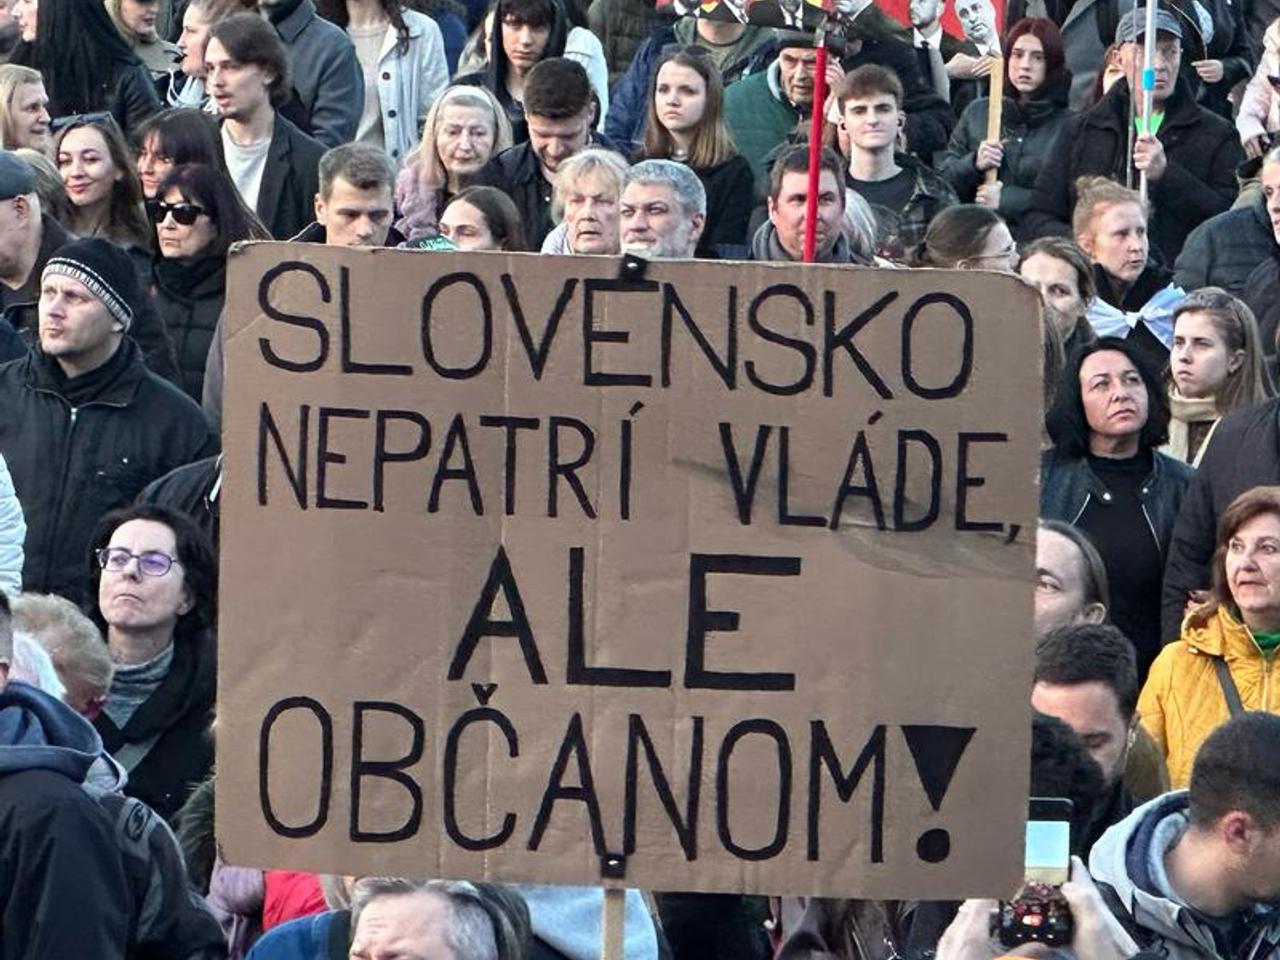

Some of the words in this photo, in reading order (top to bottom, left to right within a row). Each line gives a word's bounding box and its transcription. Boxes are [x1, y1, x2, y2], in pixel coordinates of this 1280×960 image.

[258, 261, 973, 400] SLOVENSKO
[257, 401, 644, 521] NEPATRÍ
[718, 410, 1021, 546] VLÁDE,
[448, 545, 801, 691] ALE
[258, 683, 978, 865] OBČANOM!
